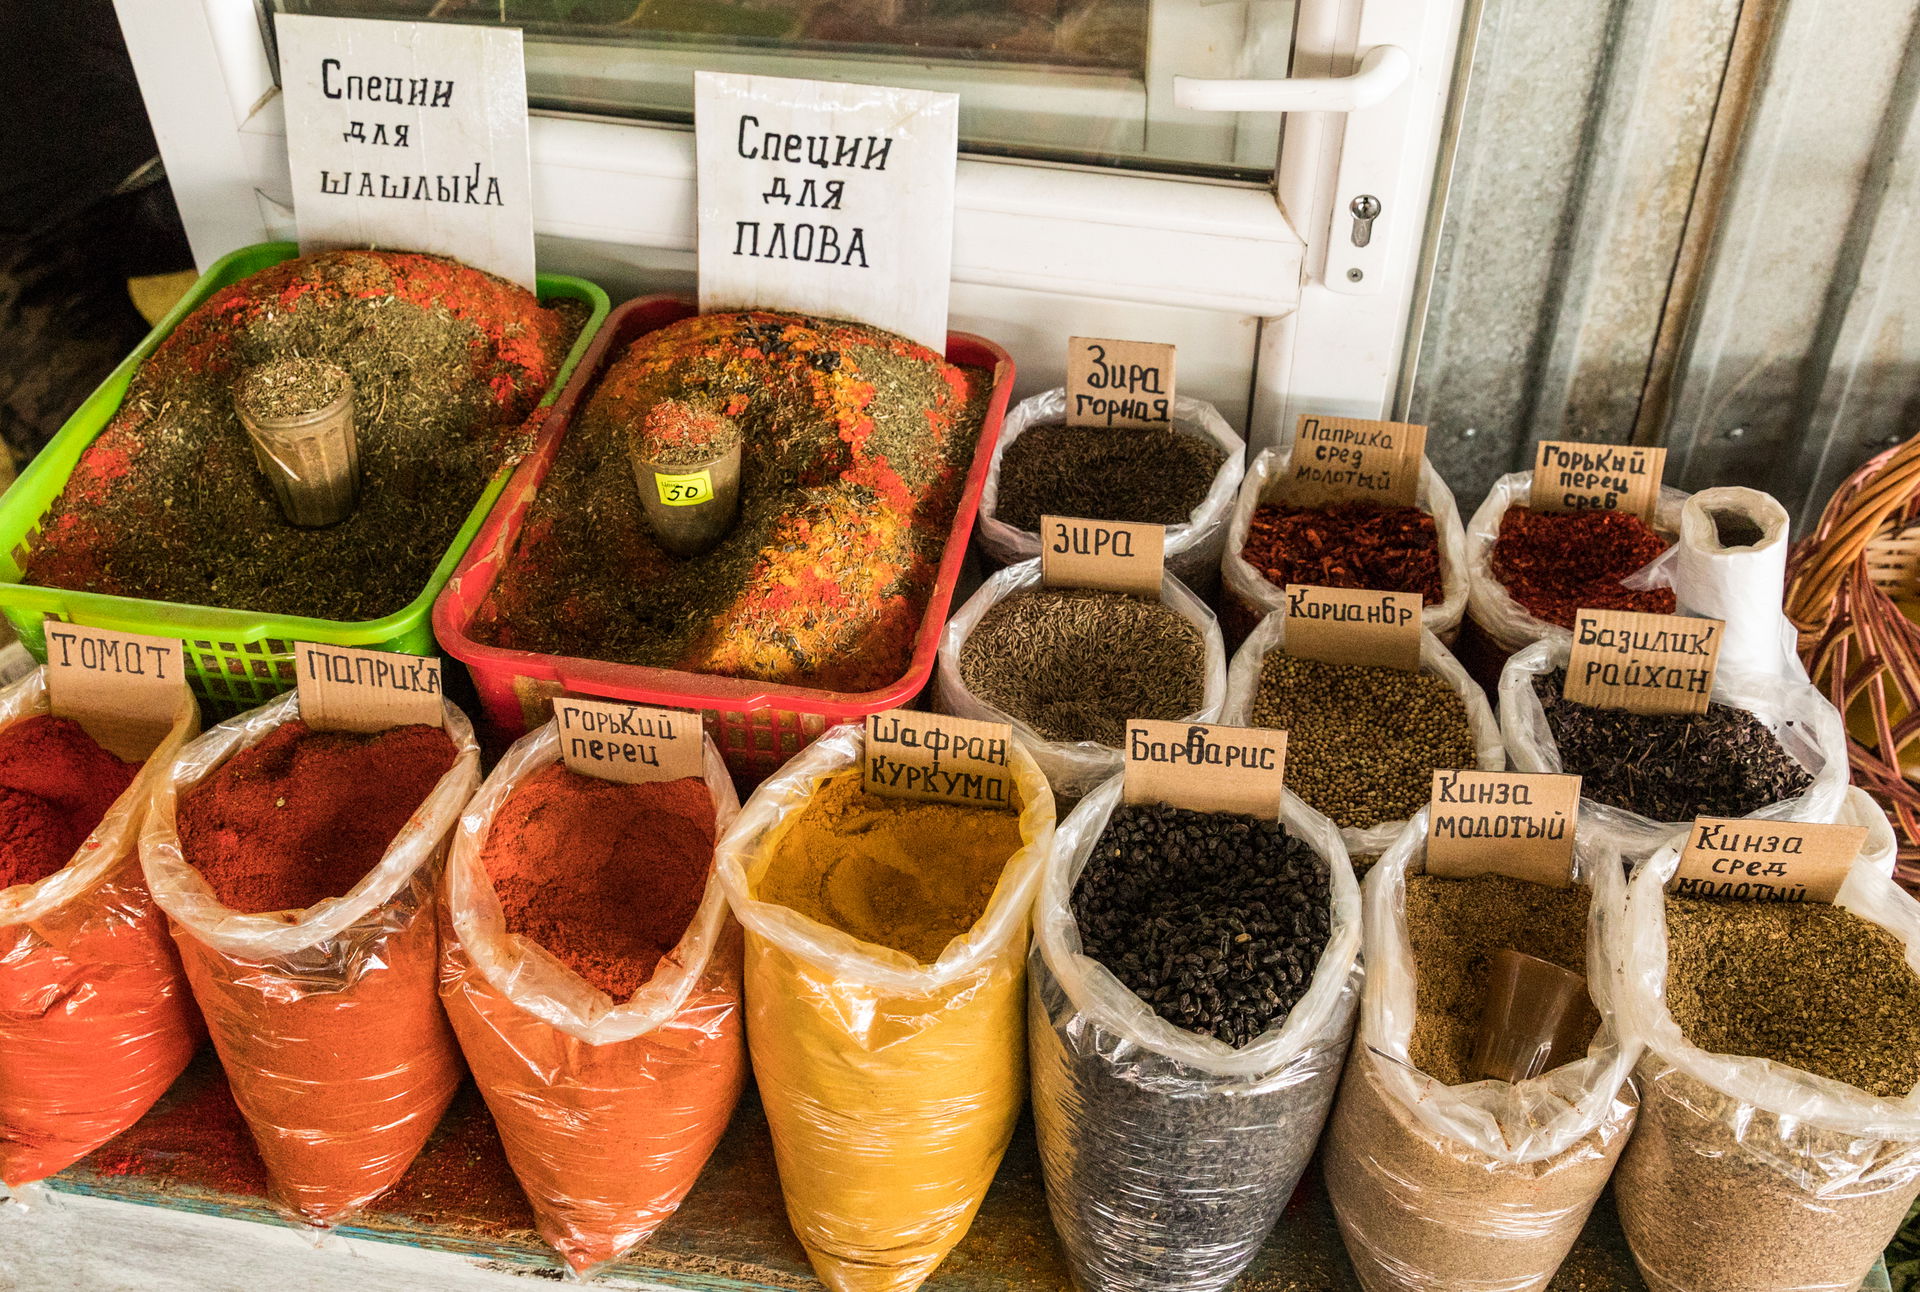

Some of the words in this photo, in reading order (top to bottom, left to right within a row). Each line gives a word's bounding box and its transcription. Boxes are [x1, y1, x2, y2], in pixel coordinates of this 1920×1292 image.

[322, 58, 454, 108] Специи
[343, 121, 410, 147] для
[738, 115, 893, 170] Специи
[762, 177, 845, 210] для
[732, 221, 870, 268] ПЛОВА
[1087, 345, 1165, 394] Зира
[1302, 419, 1393, 450] Паприка
[667, 485, 698, 501] 50
[1560, 471, 1628, 494] перец
[1579, 616, 1715, 656] Базилик
[572, 738, 660, 766] перец
[871, 715, 1007, 767] Шафран
[1131, 726, 1276, 770] Барбарис
[1439, 769, 1533, 805] Кинза
[1696, 824, 1803, 854] Кинза
[1712, 858, 1788, 877] сред
